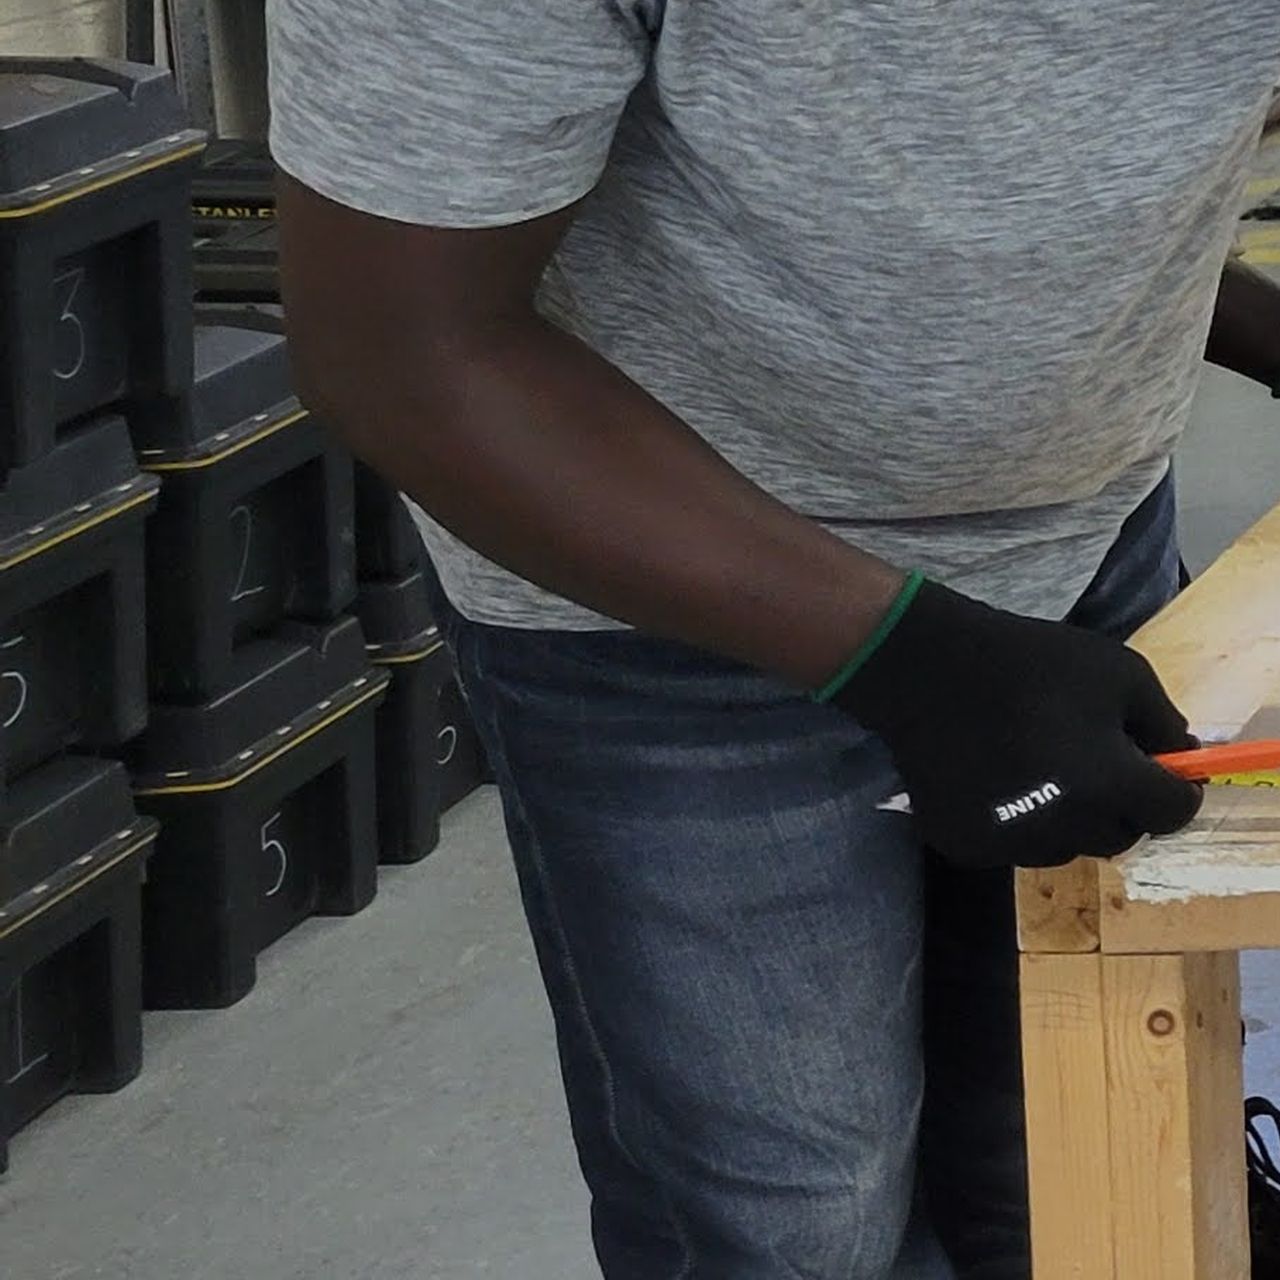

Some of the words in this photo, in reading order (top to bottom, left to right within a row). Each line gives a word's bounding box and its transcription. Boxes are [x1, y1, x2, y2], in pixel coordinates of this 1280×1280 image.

[230, 505, 266, 602] 2
[995, 782, 1062, 822] ULINE
[260, 812, 288, 897] 5
